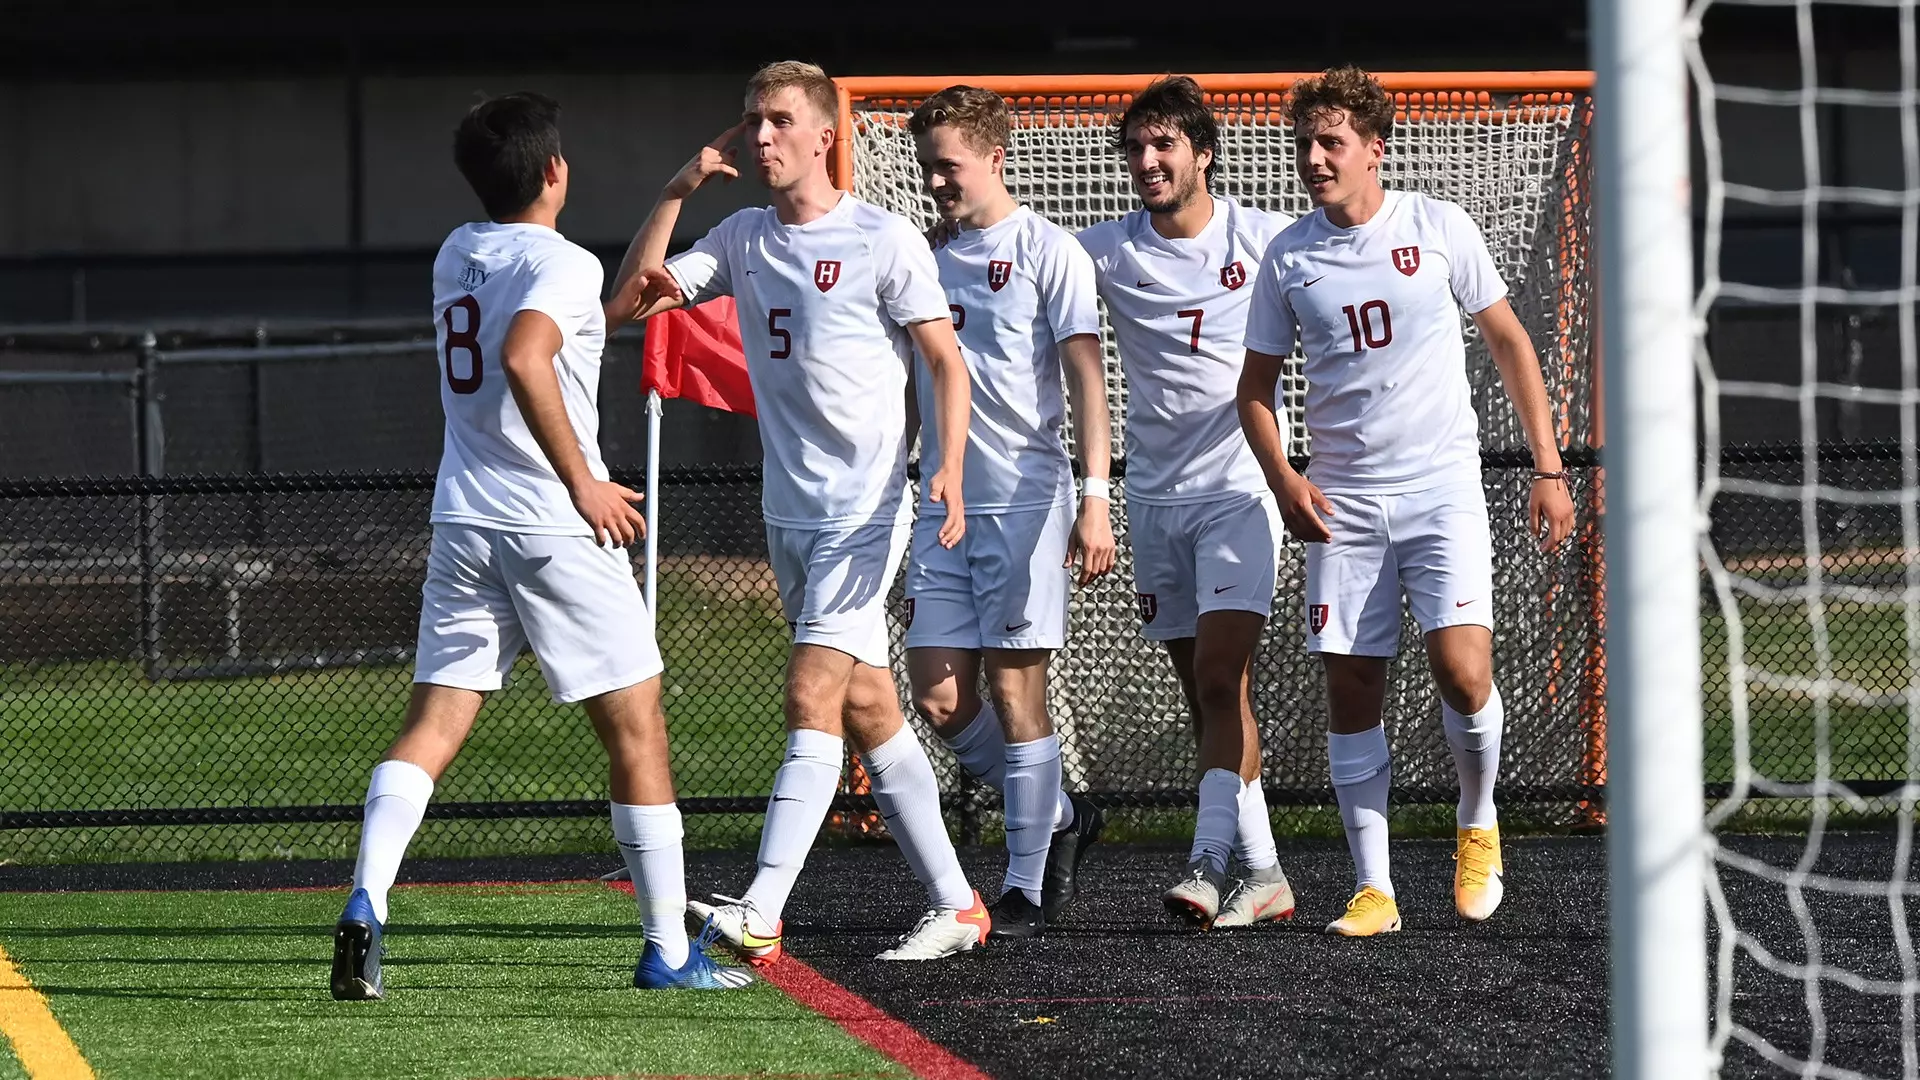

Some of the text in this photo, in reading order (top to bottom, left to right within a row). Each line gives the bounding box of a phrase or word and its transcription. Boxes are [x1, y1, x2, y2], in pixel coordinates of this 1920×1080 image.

[1397, 249, 1417, 269] H
[464, 267, 491, 286] IVY
[818, 263, 835, 284] H
[991, 263, 1007, 284] H
[1225, 265, 1242, 286] H
[768, 308, 792, 359] 5
[1177, 308, 1205, 353] 7
[1342, 299, 1393, 352] 10
[443, 294, 484, 395] 8
[1311, 609, 1323, 627] H
